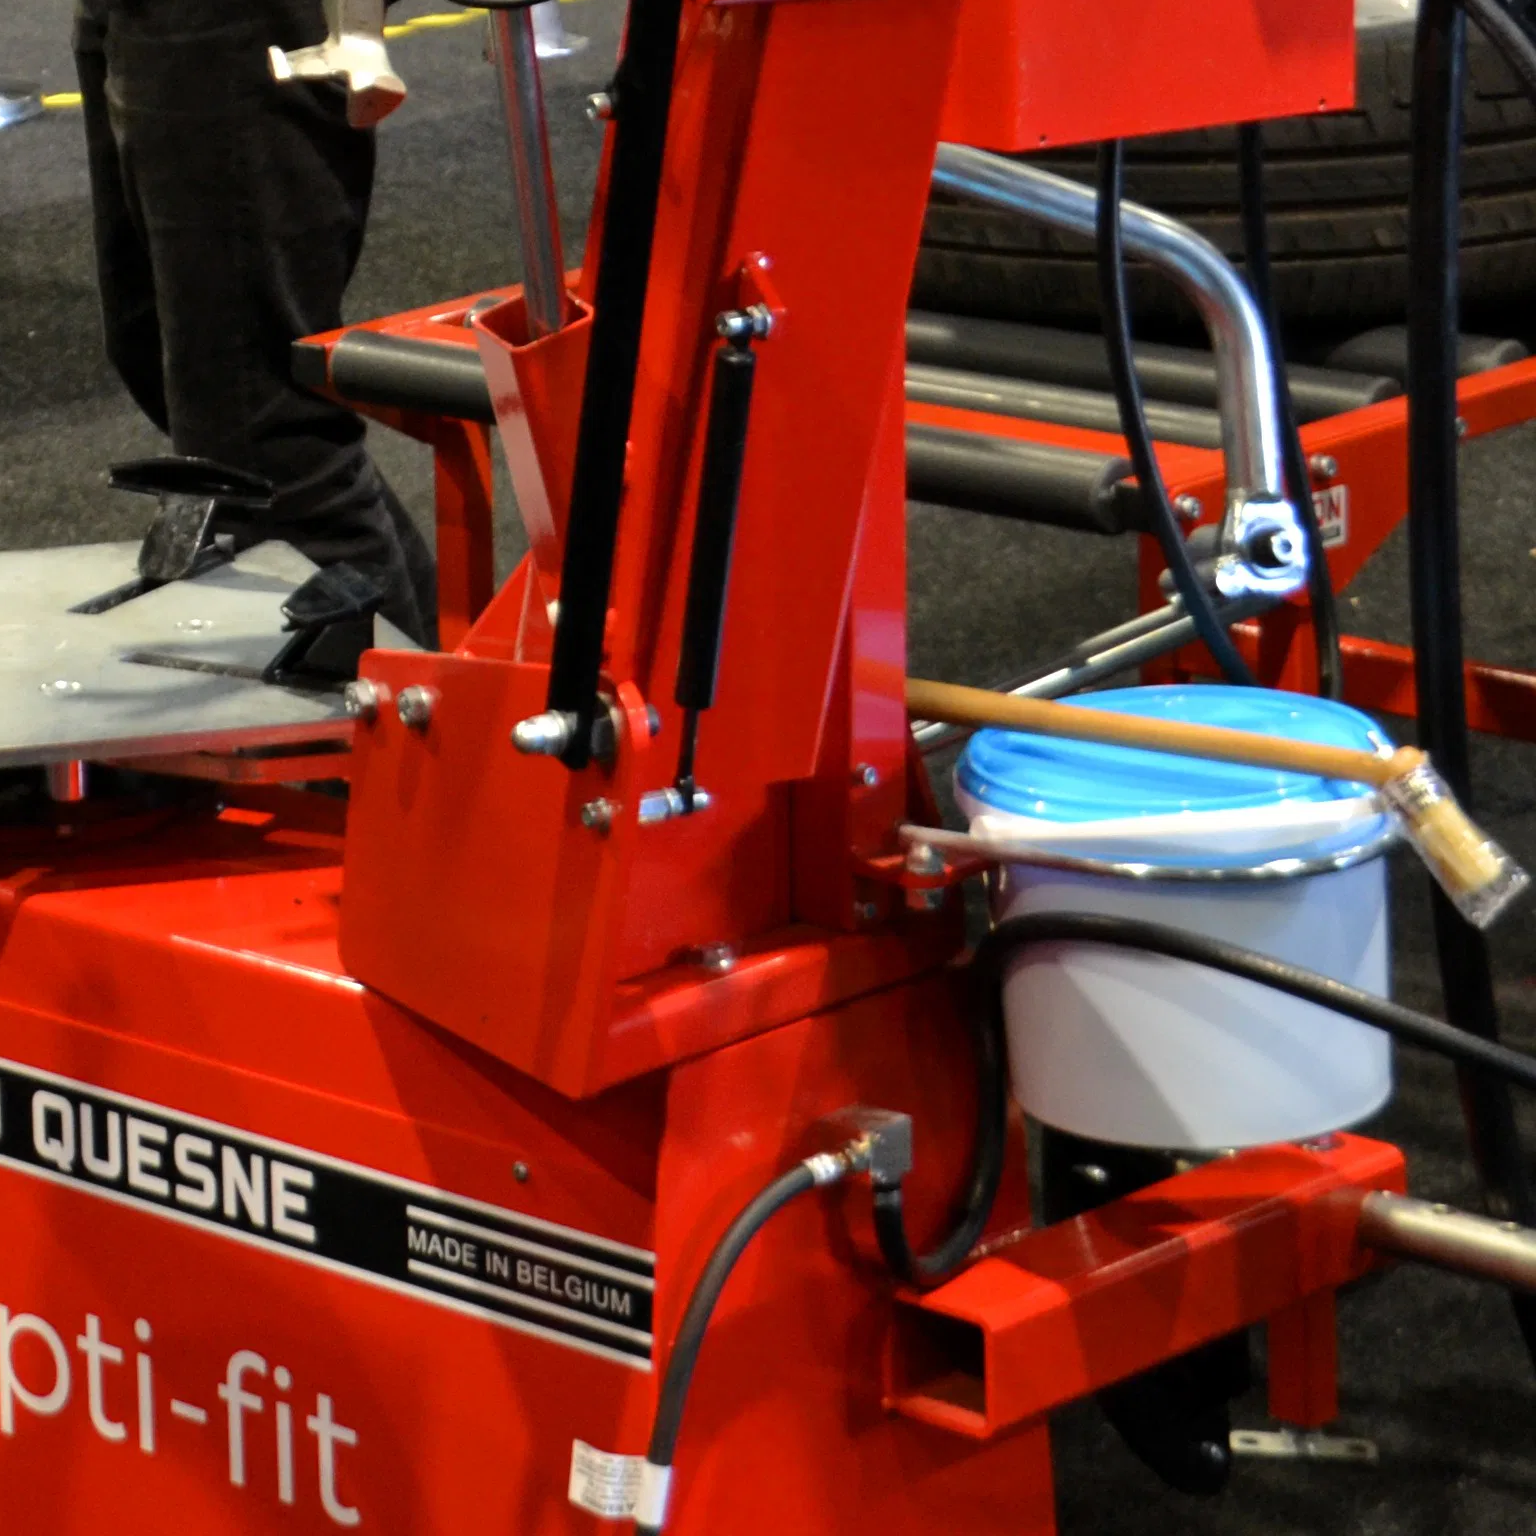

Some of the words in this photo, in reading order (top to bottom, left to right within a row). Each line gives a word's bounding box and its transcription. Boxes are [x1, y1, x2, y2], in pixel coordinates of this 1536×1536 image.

[32, 1090, 316, 1243] QUESNE
[408, 1226, 477, 1269] MADE
[485, 1250, 510, 1279] IN
[516, 1260, 631, 1316] BELGIUM
